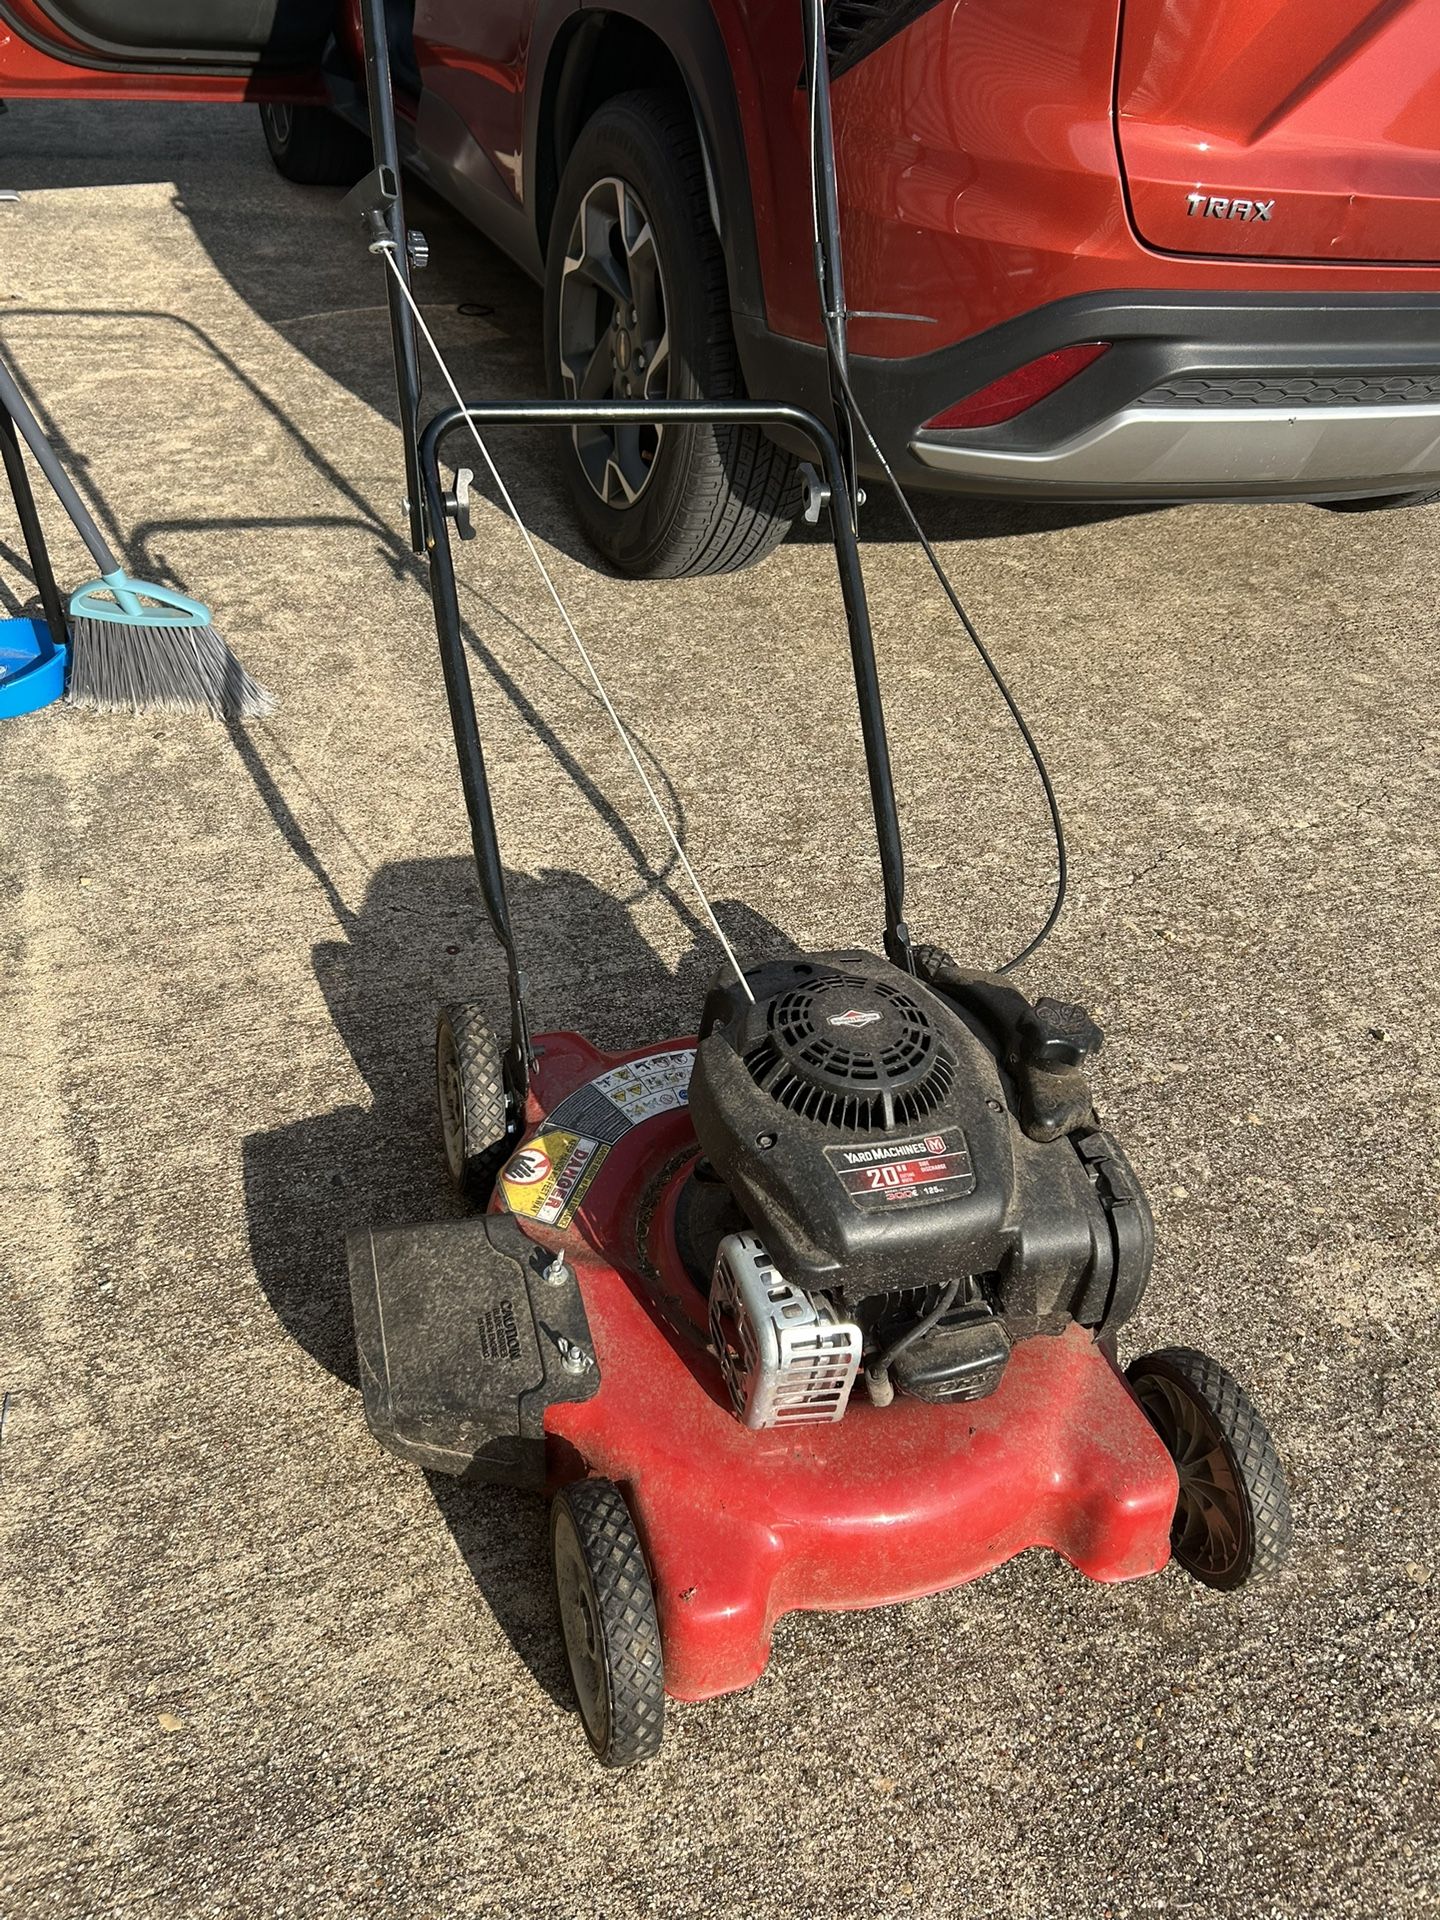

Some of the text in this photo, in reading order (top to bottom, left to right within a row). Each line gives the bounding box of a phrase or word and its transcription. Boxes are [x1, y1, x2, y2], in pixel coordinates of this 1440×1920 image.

[1185, 193, 1275, 221] TRAX
[540, 1181, 552, 1195] FEET
[546, 1149, 589, 1208] DANGER
[530, 1195, 544, 1212] AWAY
[500, 1300, 521, 1360] CAUTION
